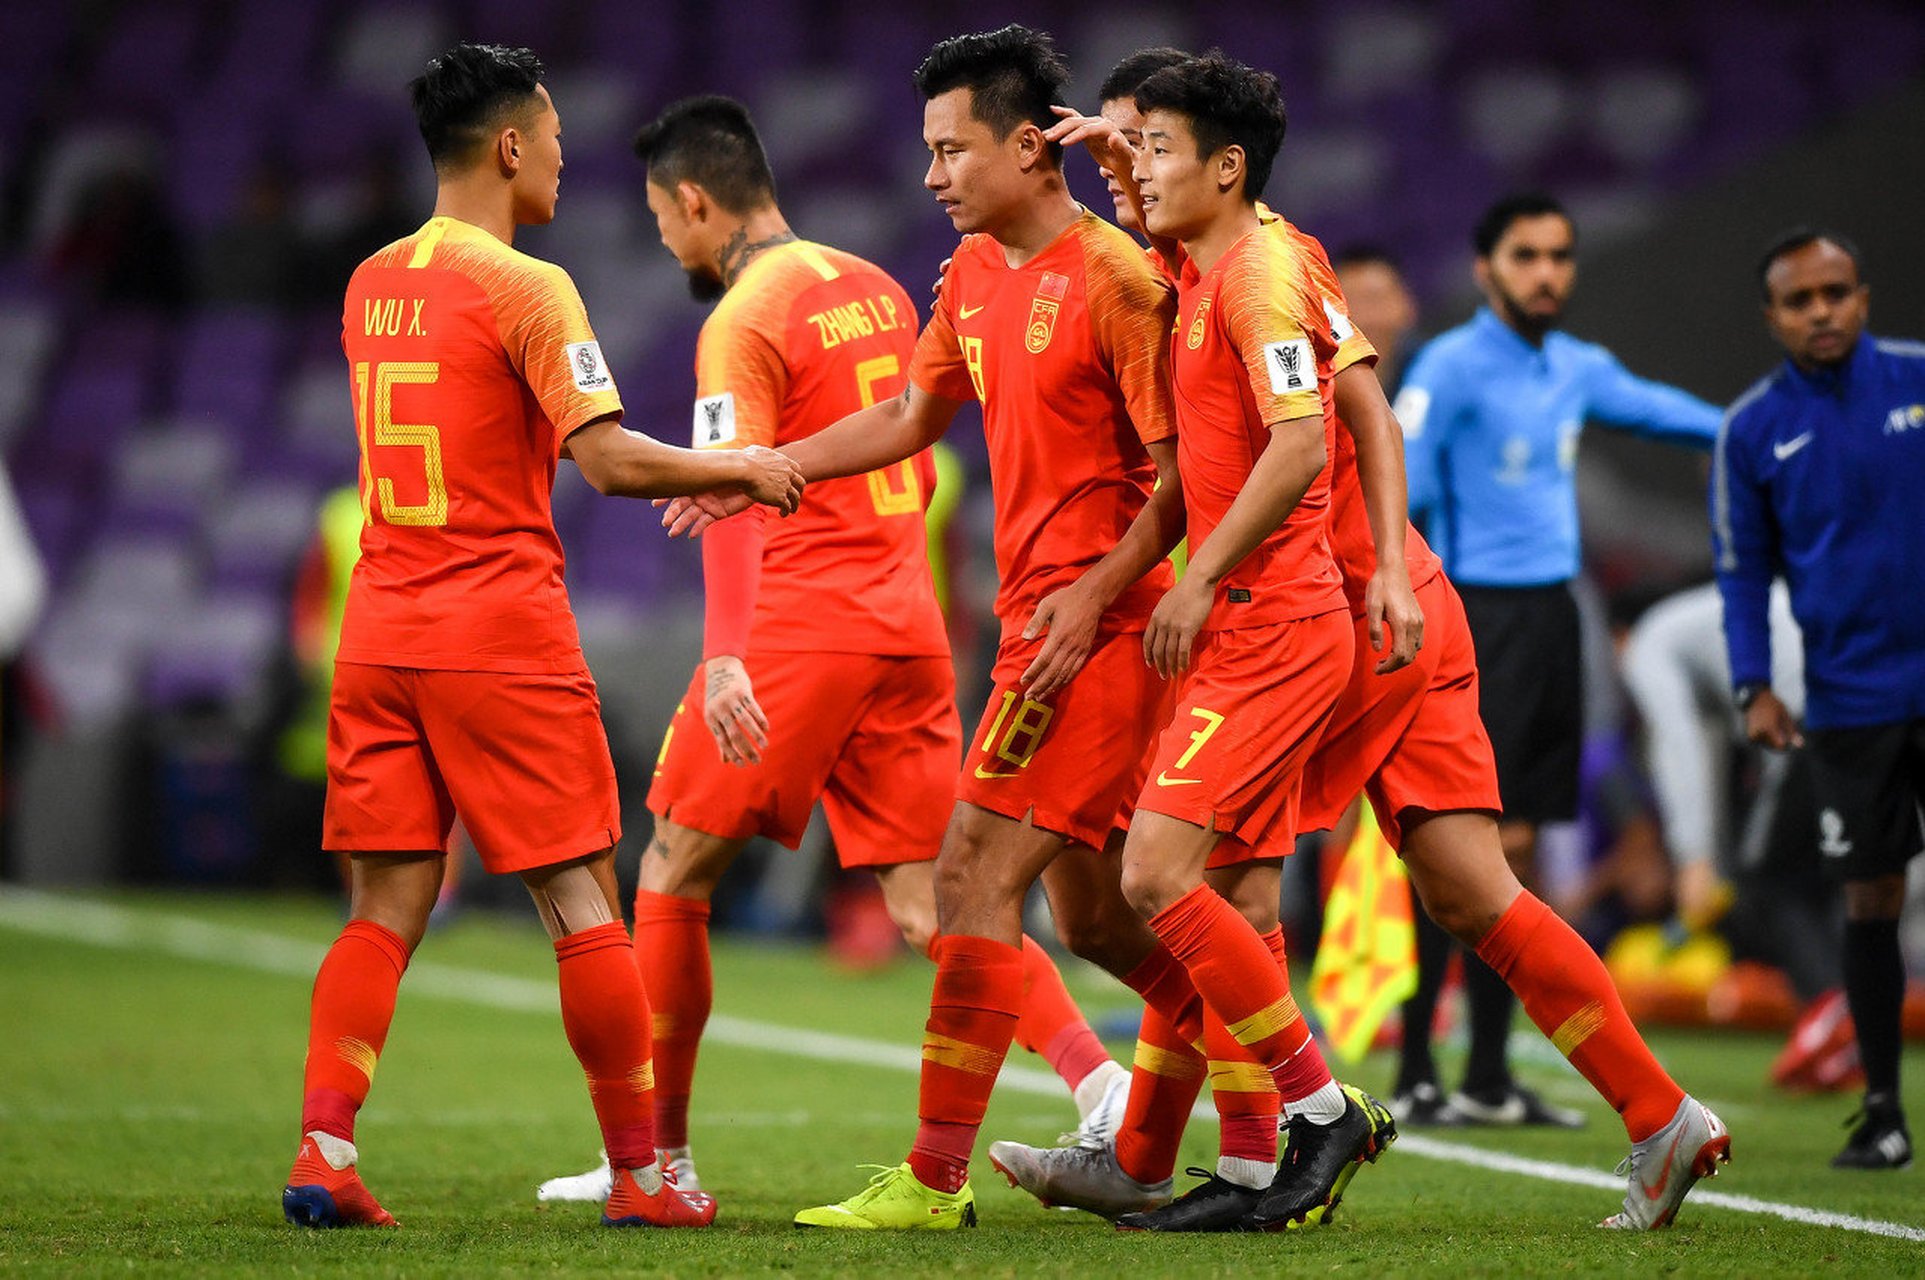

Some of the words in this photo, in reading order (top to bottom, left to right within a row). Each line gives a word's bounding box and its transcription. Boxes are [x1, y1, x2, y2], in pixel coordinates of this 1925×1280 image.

[364, 298, 404, 336] WU
[407, 298, 427, 336] X.
[806, 301, 875, 349] ZHANG
[355, 361, 448, 528] 15
[981, 690, 1055, 769] 18
[1174, 707, 1225, 770] 7
